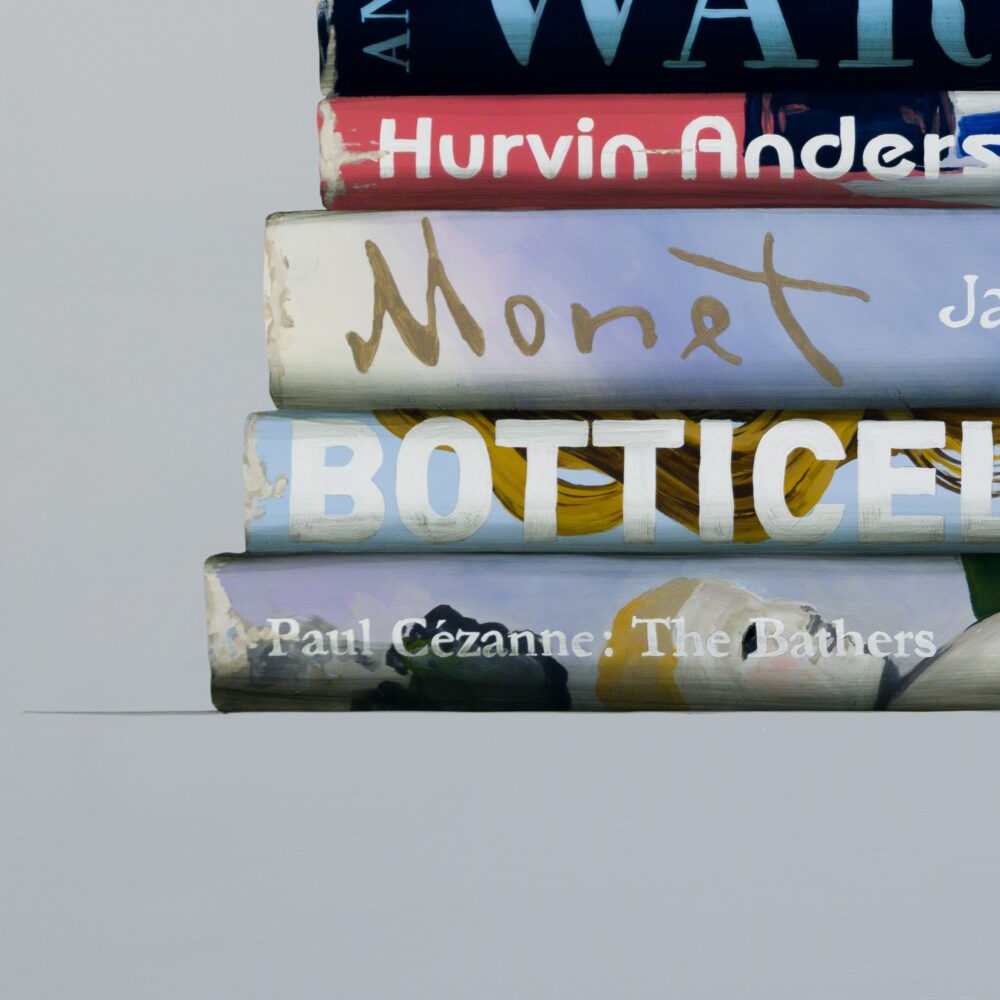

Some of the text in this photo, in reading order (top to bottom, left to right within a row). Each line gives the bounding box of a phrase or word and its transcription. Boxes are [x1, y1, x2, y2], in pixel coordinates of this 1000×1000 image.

[379, 116, 648, 180] Hurvin
[345, 216, 871, 387] Monet
[266, 616, 937, 660] Paul Cézanne: The Bathers
